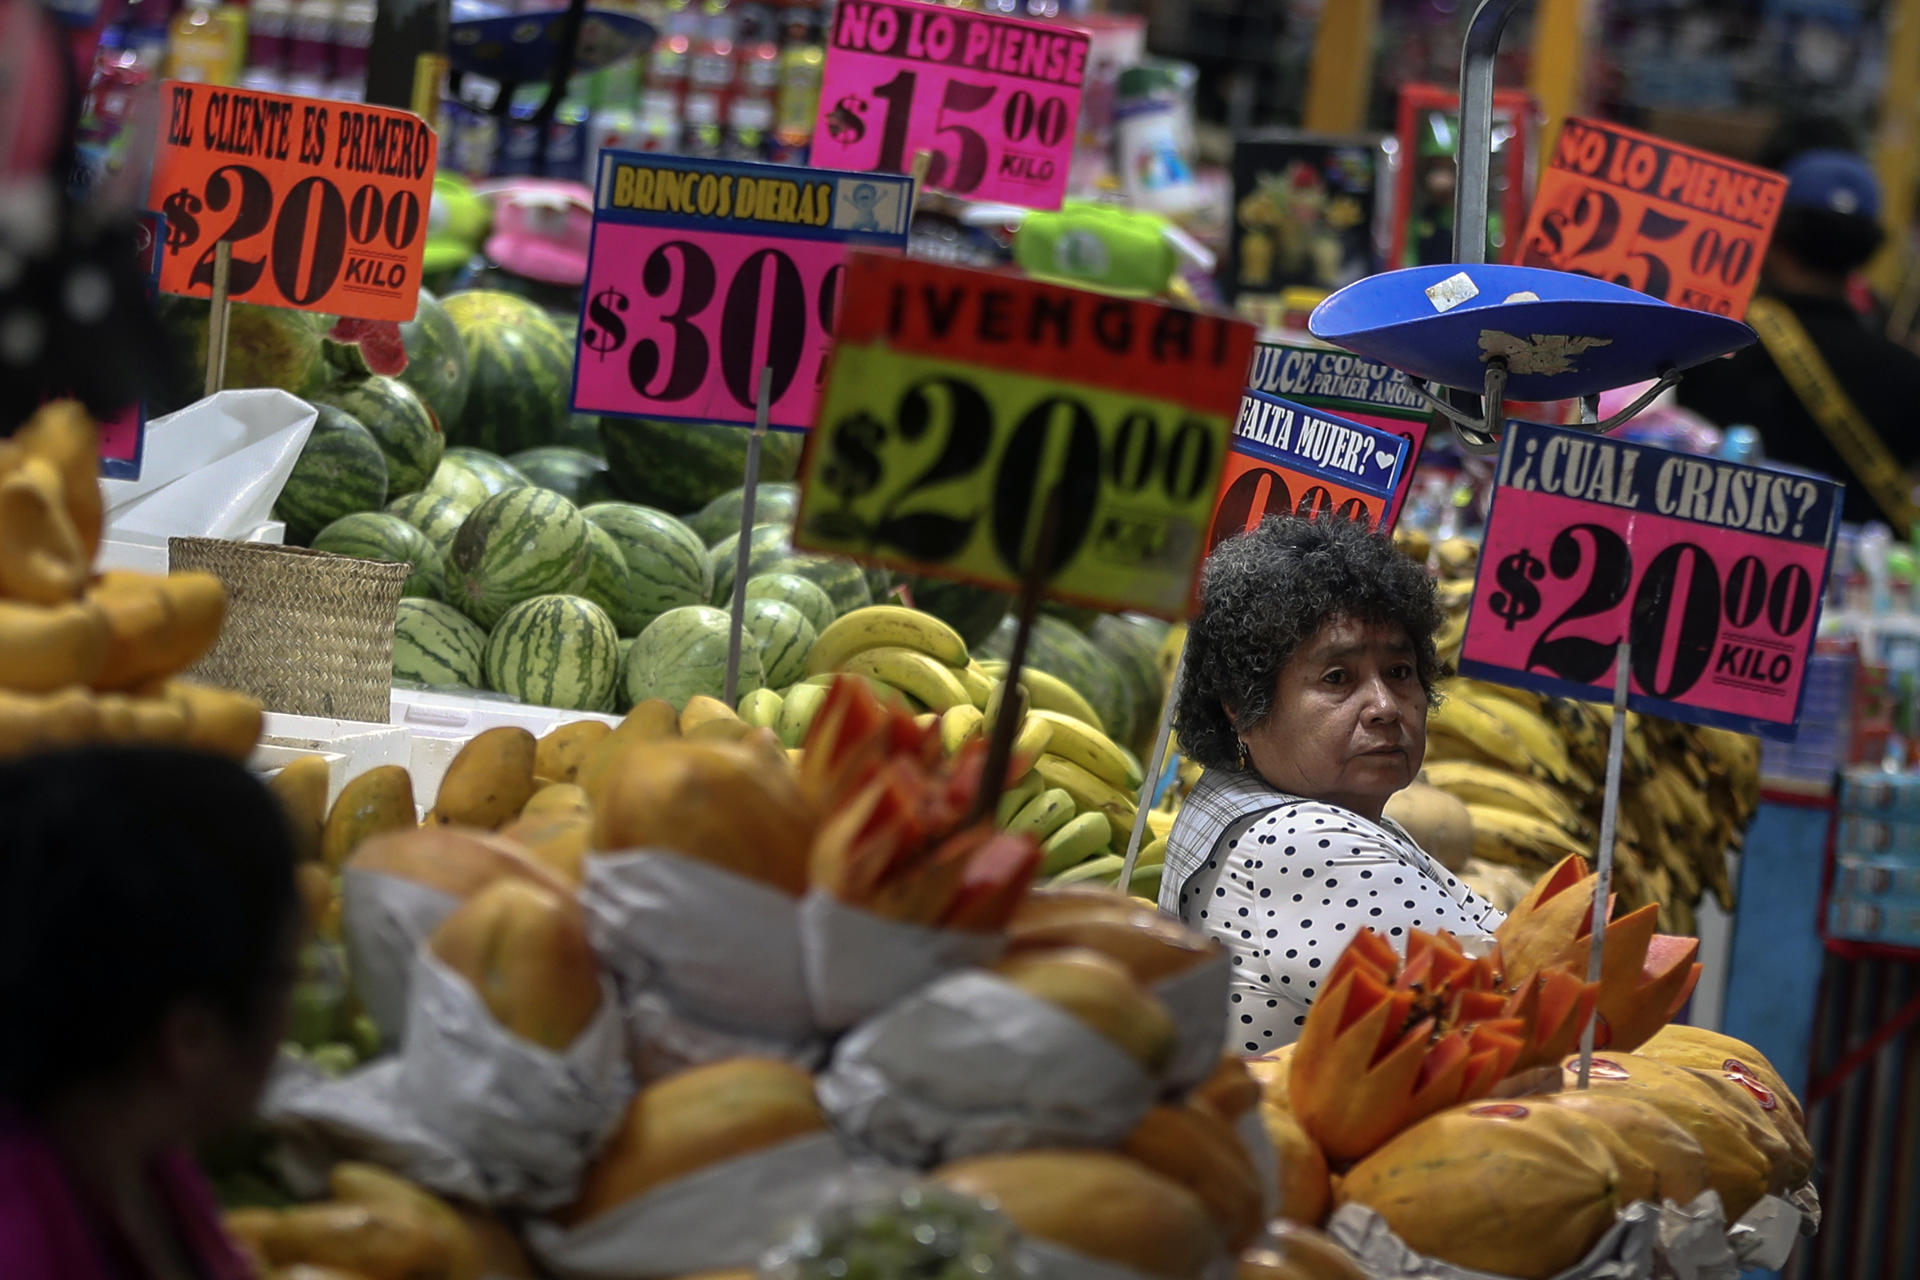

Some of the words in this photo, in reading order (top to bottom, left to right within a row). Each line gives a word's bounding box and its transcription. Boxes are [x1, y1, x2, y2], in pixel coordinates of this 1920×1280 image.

[836, 3, 898, 52] NO
[906, 12, 956, 61] LO
[963, 21, 1087, 85] PIENSE
[168, 87, 193, 148] EL
[204, 92, 293, 161] CLIENTE
[299, 105, 328, 166] ES
[334, 111, 430, 180] PRIMERO
[612, 164, 733, 219] BRINCOS
[733, 175, 833, 227] DIERAS
[999, 153, 1054, 181] KILO
[1555, 124, 1609, 174] NO
[1608, 139, 1657, 190] LO
[1658, 152, 1776, 225] PIENSE
[344, 257, 406, 289] KILO
[1249, 345, 1318, 394] ULCE
[1319, 354, 1389, 380] COMO
[1309, 372, 1371, 400] PRIMER
[1232, 395, 1295, 452] FALTA
[1294, 415, 1377, 476] MUJER?
[1511, 434, 1640, 509] ¿CUAL
[1654, 456, 1818, 538] CRISIS?
[1714, 643, 1792, 685] KILO
